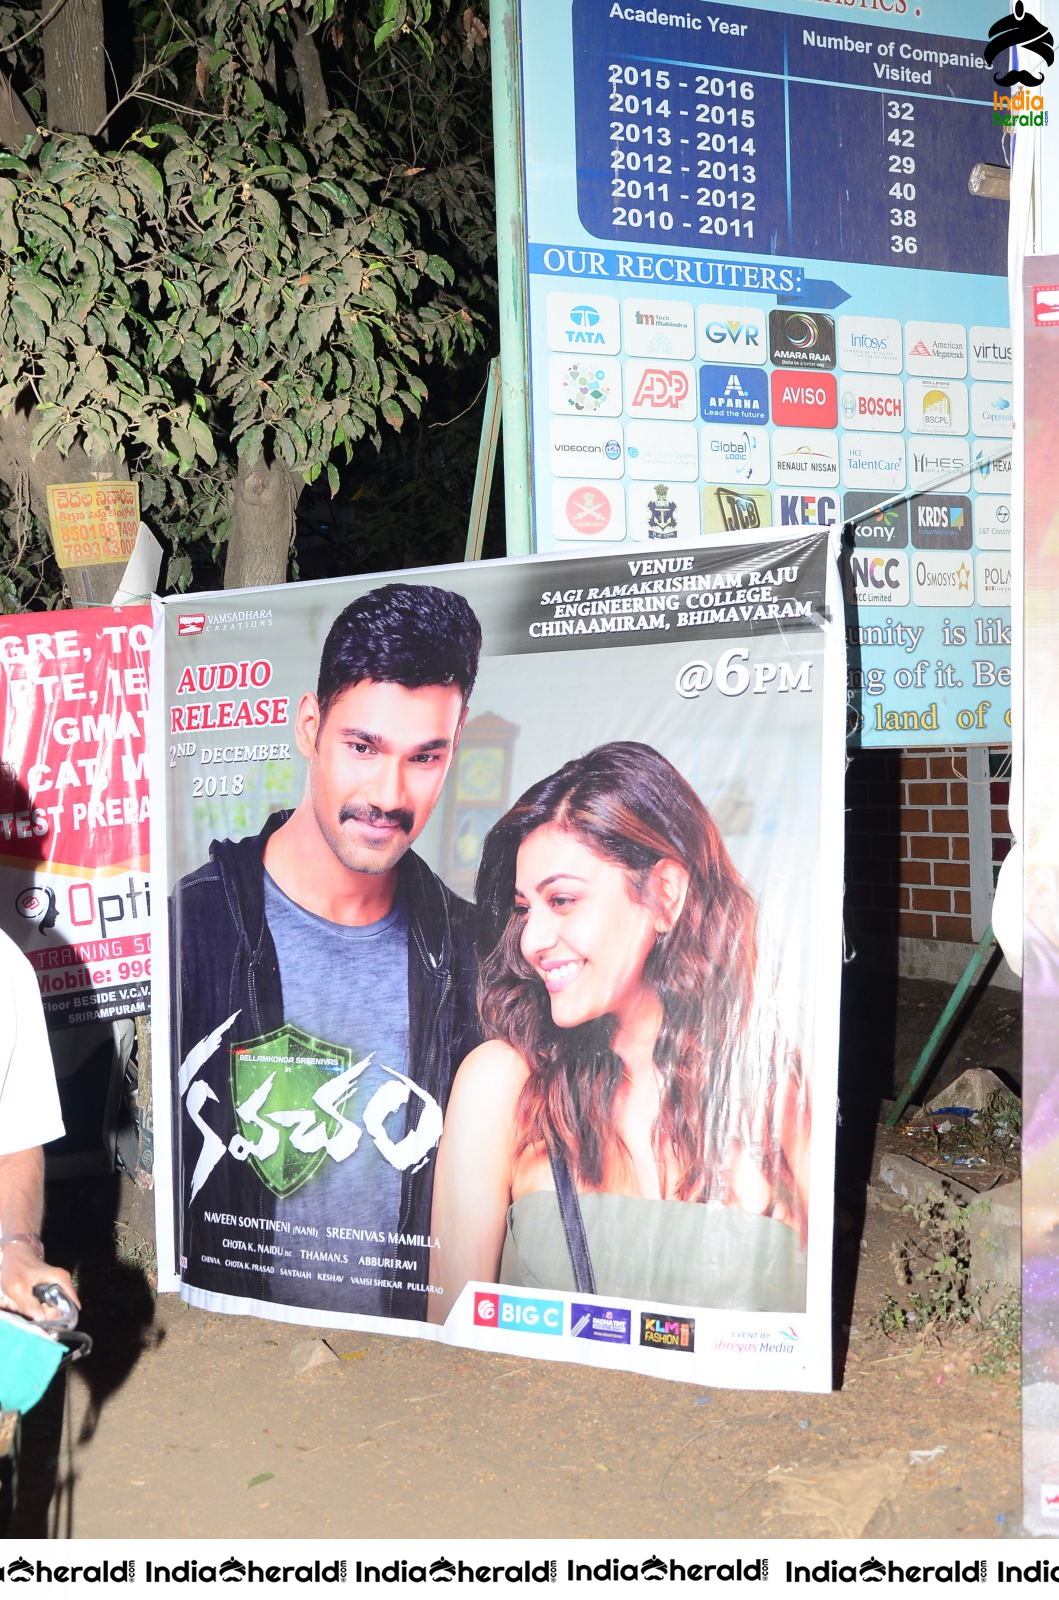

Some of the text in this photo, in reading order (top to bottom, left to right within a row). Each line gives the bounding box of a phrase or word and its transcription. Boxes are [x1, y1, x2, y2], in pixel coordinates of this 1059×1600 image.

[609, 2, 748, 37] Academic Year
[802, 29, 872, 54] Number
[877, 42, 895, 57] of
[608, 64, 755, 101] 2015 2016
[873, 62, 932, 85] Visited
[608, 93, 755, 129] 2014 2015
[887, 100, 915, 121] 32
[609, 121, 756, 156] 2013 2014
[887, 128, 915, 148] 42
[610, 150, 756, 183] 2012 2013
[888, 155, 916, 174] 29
[611, 178, 756, 211] 2011 2012
[888, 182, 916, 201] 40
[612, 206, 753, 239] 2010 2011
[890, 208, 917, 228] 38
[890, 235, 918, 254] 36
[543, 248, 802, 293] OUR RECRUITERS:
[565, 330, 606, 345] TATA
[705, 320, 760, 347] GVR
[851, 333, 887, 351] Infosys
[932, 340, 963, 350] American
[774, 350, 831, 362] AMARA RAJA
[932, 349, 964, 359] Megatrends
[632, 368, 689, 409] ADP
[782, 386, 826, 406] AVISO
[704, 409, 725, 417] Lead
[741, 411, 765, 419] future
[709, 397, 760, 410] APARNA
[859, 397, 902, 417] BOSCH
[924, 415, 949, 424] BSCPL
[711, 440, 747, 453] Global
[725, 453, 747, 461] LOGIC
[777, 461, 837, 473] RENAULT NISSAN
[848, 458, 900, 471] TalentCare
[727, 495, 756, 531] JCB
[780, 495, 836, 526] KEC
[917, 506, 949, 528] KRDS
[627, 556, 694, 578] VENUE
[852, 557, 900, 589] NCC
[540, 566, 799, 606] SAGI RAMAKRISHNAM RAJU
[868, 593, 892, 602] Limited
[553, 586, 779, 619] ENGINEERING COLLEGE,
[206, 609, 273, 625] VAMSADHARA
[206, 619, 274, 632] CREATIONS
[528, 600, 813, 638] CHINAAMIRAM, BHIMAVARAM
[943, 618, 966, 645] is
[0, 630, 92, 663] GRE,
[176, 659, 273, 695] AUDIO
[894, 660, 929, 688] of
[936, 660, 963, 688] it.
[972, 660, 1011, 688] Be
[170, 697, 289, 735] RELEASE
[874, 703, 939, 731] land
[957, 701, 991, 729] of
[169, 742, 291, 768] 2ND DECEMBER
[192, 774, 245, 798] 2018
[0, 805, 65, 840] TEST
[68, 876, 151, 938] Opti
[38, 941, 122, 968] TRAINING
[40, 968, 112, 993] Mobile:
[73, 991, 117, 1008] BESIDE
[68, 1001, 146, 1024] SRIRAMPURAM
[239, 1054, 294, 1064] BELLAMKONDA
[204, 1211, 441, 1249] NAVEEN SONTINENI (NANI) SREENIVAS MAMILLA
[222, 1238, 417, 1271] CHOTA K. NAIDU THAMAN.S ABBURI RAVI
[225, 1259, 244, 1269] CHOTA
[251, 1263, 275, 1274] PRASAD
[317, 1273, 344, 1282] KESHAV
[350, 1276, 373, 1286] VAMSI
[373, 1278, 403, 1289] SHEKAR
[407, 1282, 443, 1295] PULLARAO
[502, 1303, 560, 1328] BIG C
[645, 1318, 680, 1335] KLM
[644, 1332, 680, 1345] FASHION
[731, 1331, 758, 1339] EVENT
[760, 1342, 794, 1354] Media
